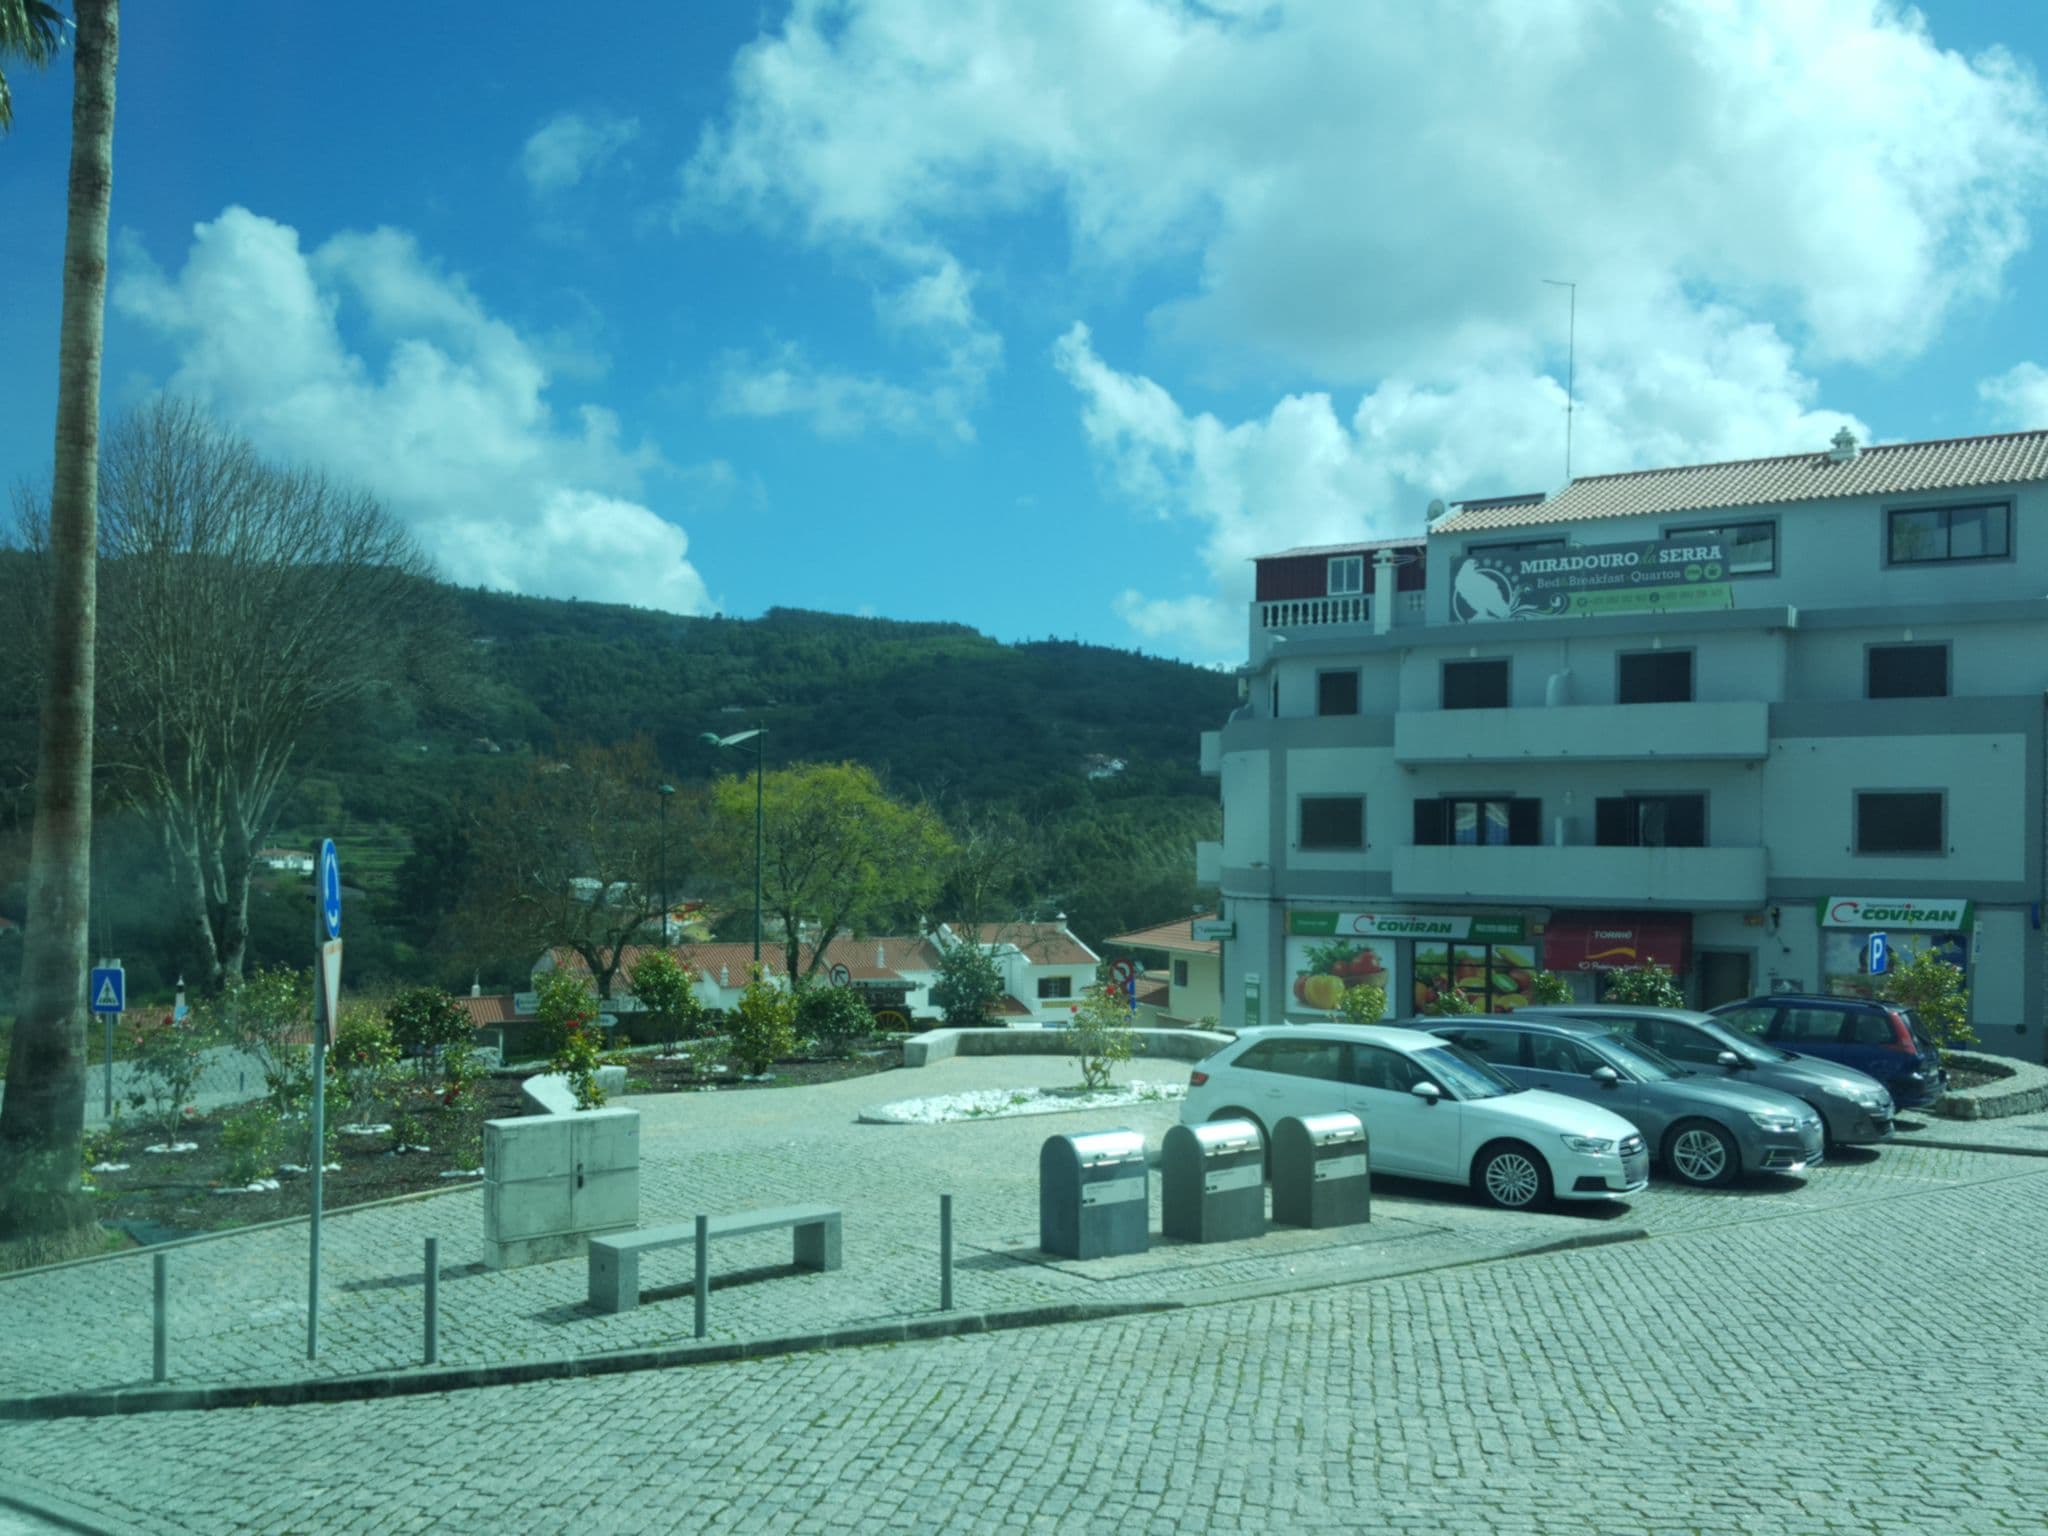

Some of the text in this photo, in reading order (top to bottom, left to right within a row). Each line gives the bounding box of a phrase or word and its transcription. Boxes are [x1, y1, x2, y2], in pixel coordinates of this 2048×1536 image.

[1520, 552, 1638, 574] MIRADOURO
[1659, 545, 1721, 564] SERRA
[1537, 577, 1560, 589] Bed
[1568, 573, 1625, 586] Breakfast
[1631, 570, 1681, 583] Quartos
[1873, 938, 1883, 970] P
